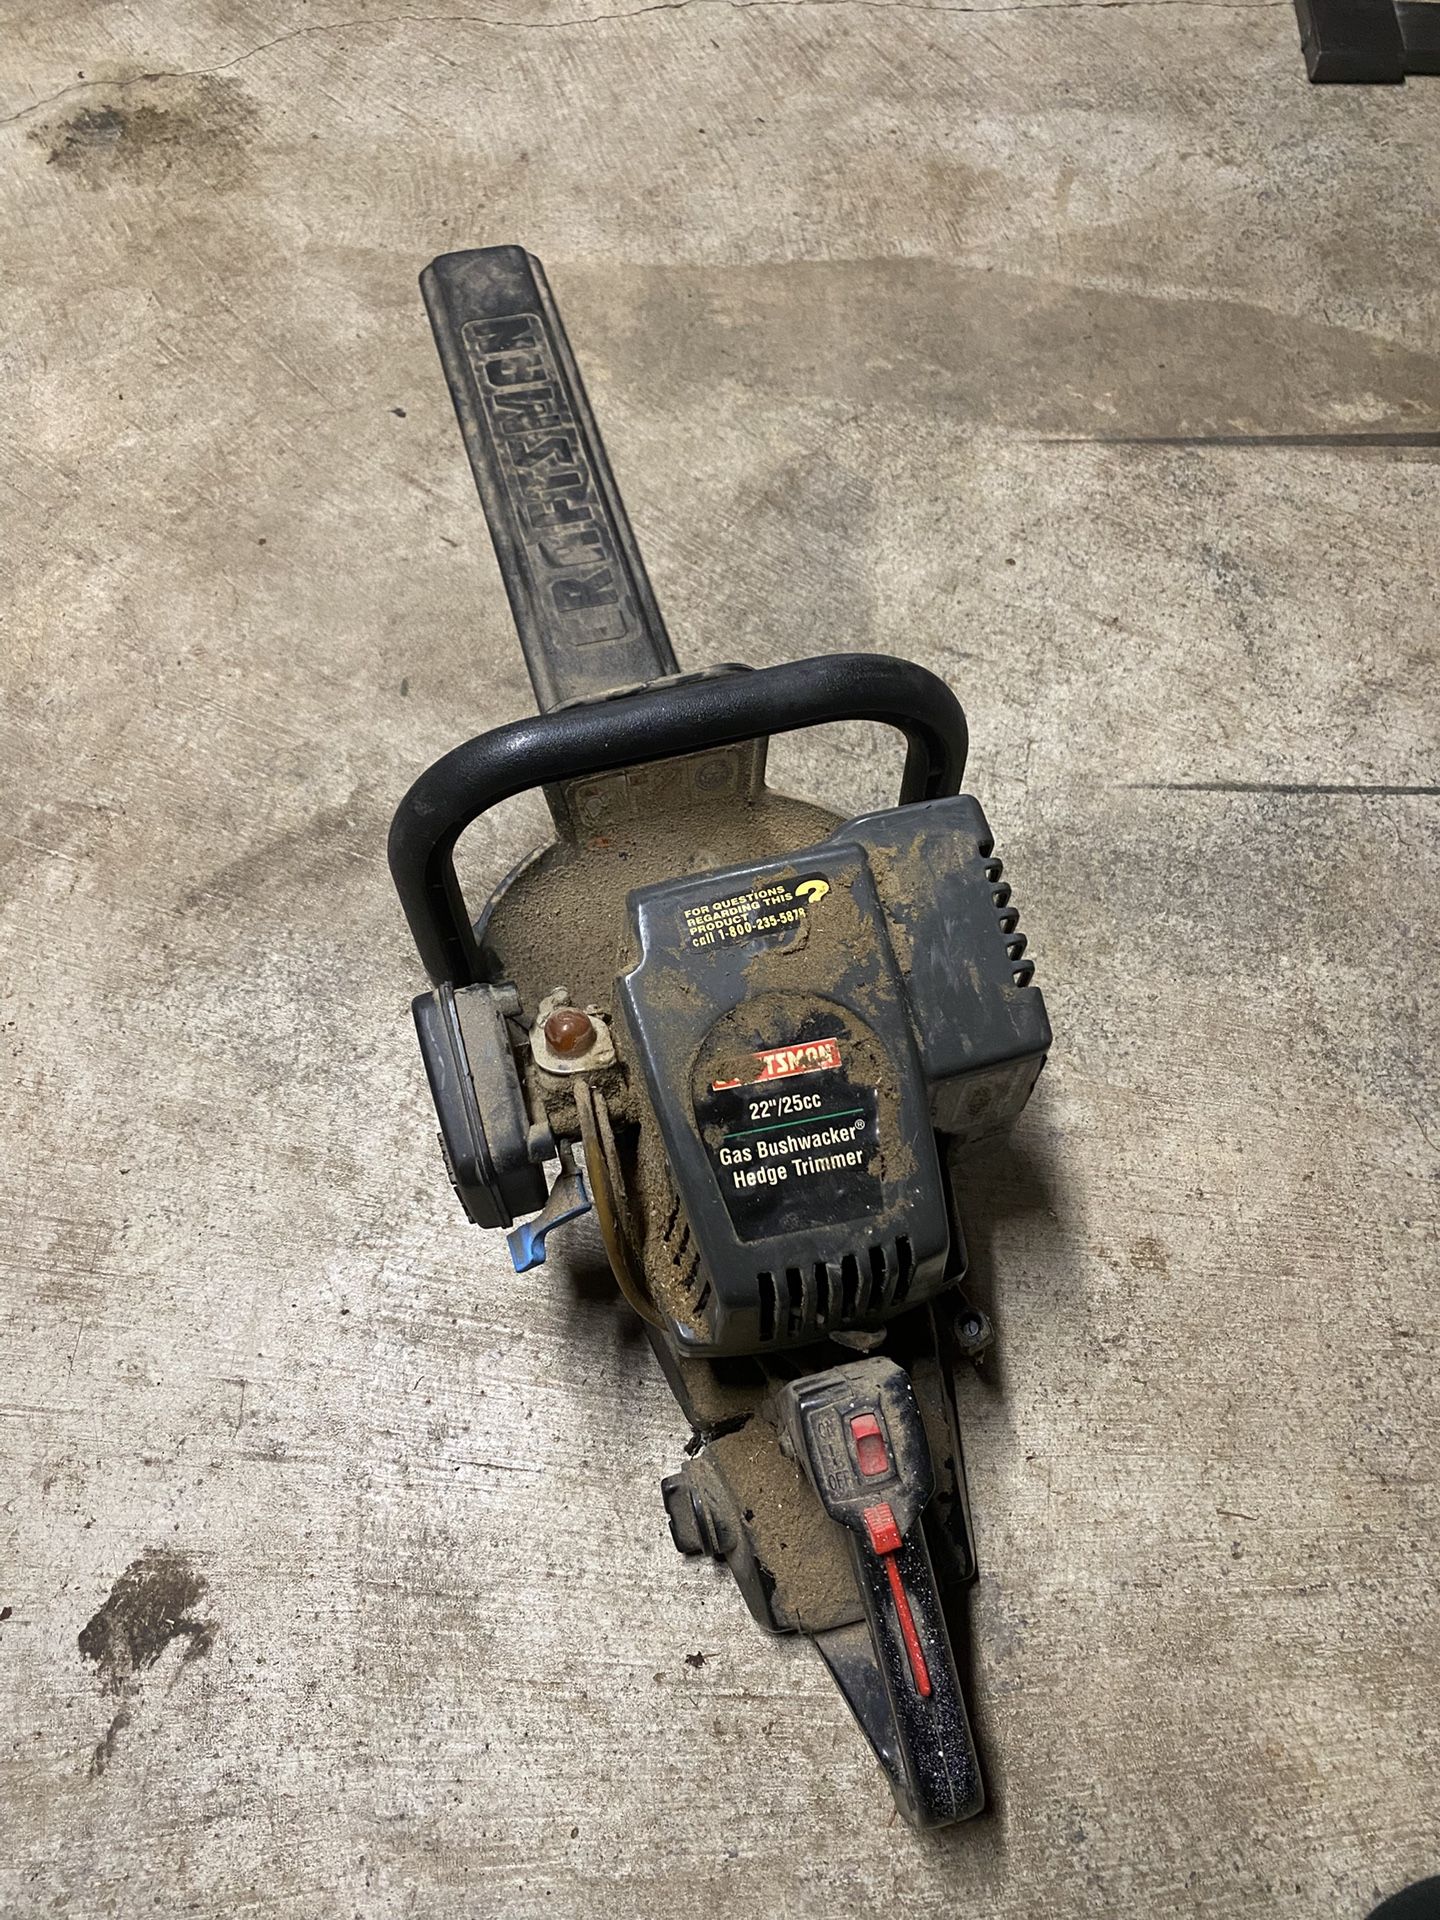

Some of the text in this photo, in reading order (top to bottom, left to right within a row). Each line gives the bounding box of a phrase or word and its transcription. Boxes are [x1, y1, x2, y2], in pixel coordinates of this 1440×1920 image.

[684, 885, 785, 919] FOR QUESTIONS
[687, 892, 793, 927] REGARDING THIS
[689, 913, 749, 936] PRODUCT
[692, 930, 715, 947] call
[749, 1093, 822, 1120] 22"/25cc
[719, 1148, 753, 1166] Gas
[733, 1149, 863, 1188] Hedge Trimmer
[828, 1470, 850, 1491] OFF
